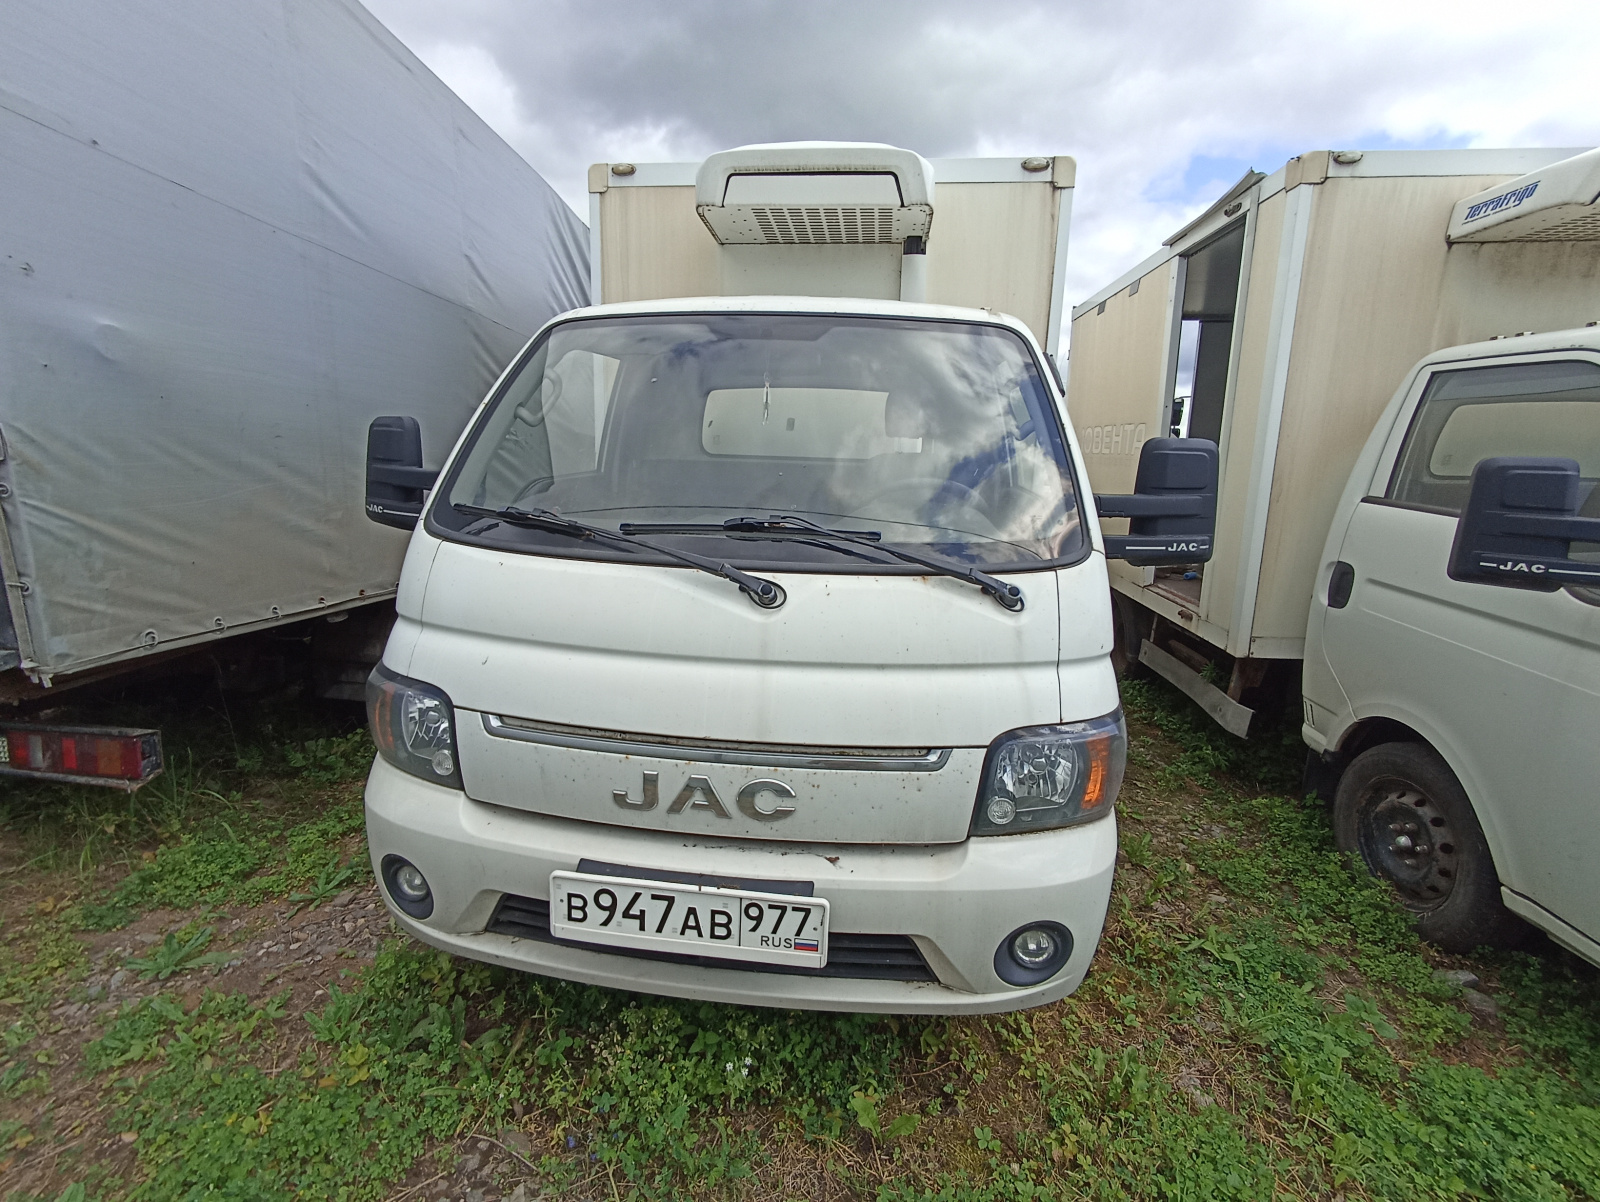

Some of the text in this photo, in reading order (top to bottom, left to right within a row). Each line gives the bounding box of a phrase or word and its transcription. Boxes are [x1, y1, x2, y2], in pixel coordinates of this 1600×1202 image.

[369, 503, 383, 513] JAC
[1167, 542, 1198, 552] JAC
[1499, 561, 1546, 573] JAC
[612, 770, 797, 822] JAC
[743, 901, 812, 937] 977
[760, 935, 793, 949] RUS
